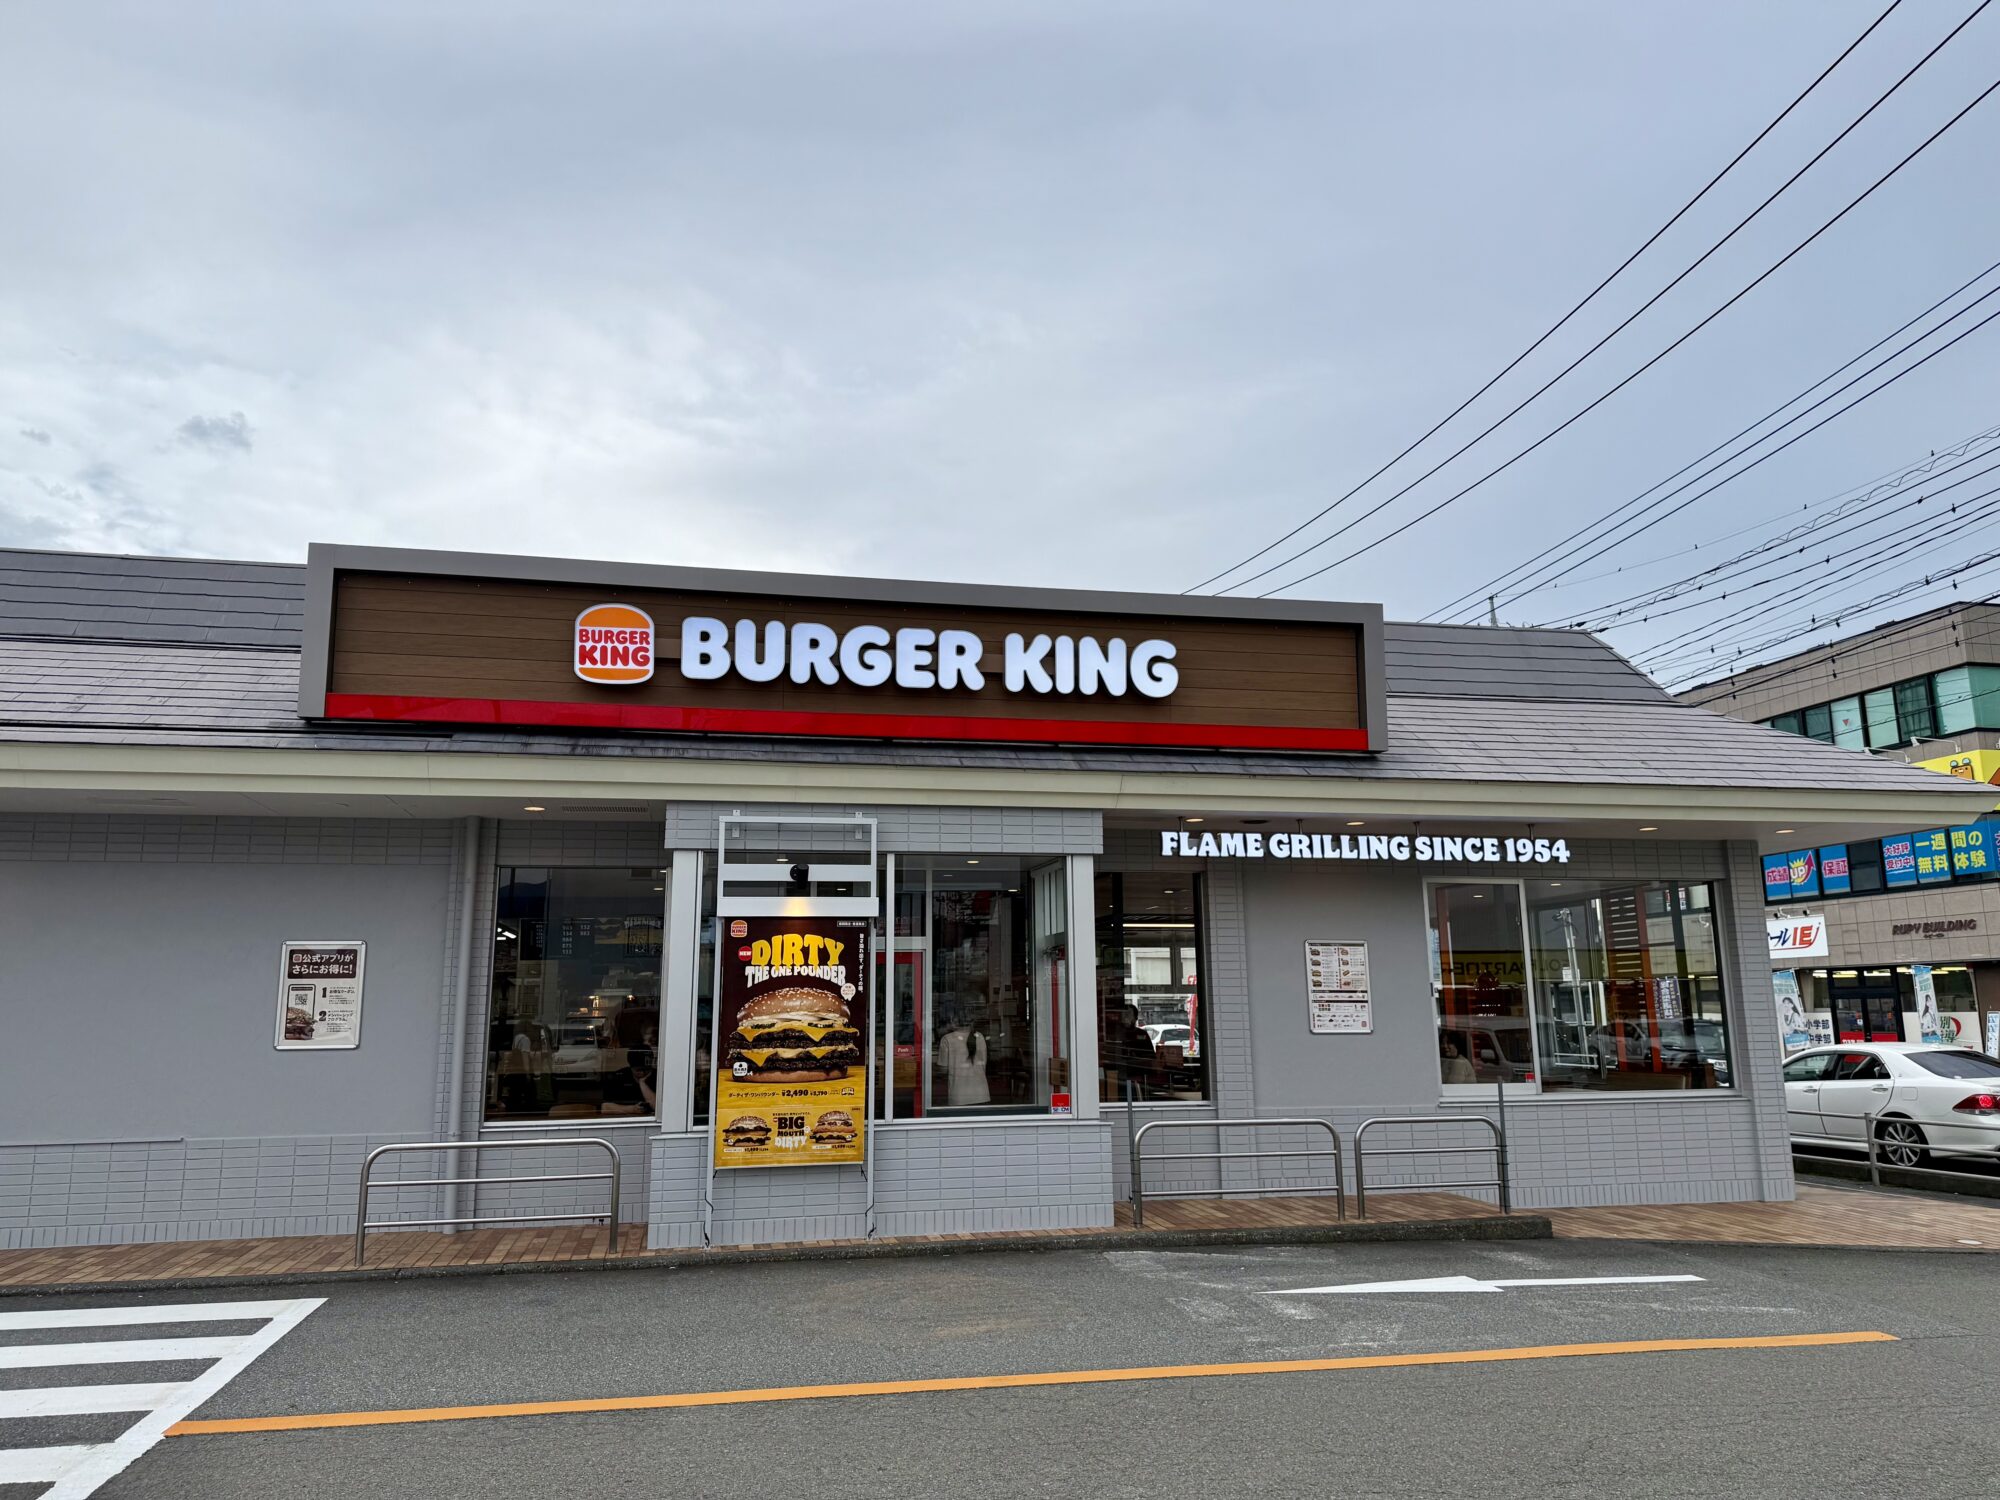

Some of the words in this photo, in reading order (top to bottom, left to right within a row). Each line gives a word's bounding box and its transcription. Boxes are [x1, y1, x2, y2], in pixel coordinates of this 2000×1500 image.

[578, 628, 651, 646] BURGER
[578, 644, 651, 668] KING
[680, 616, 985, 691] BURGER
[1003, 633, 1179, 698] KING
[1161, 831, 1264, 858] FLAME
[1269, 833, 1411, 861] GRILLING
[1415, 836, 1500, 862] SINCE
[1503, 838, 1570, 863] 1954
[1823, 859, 1848, 876] 保証
[1922, 918, 1977, 934] BUILDING
[751, 933, 845, 966] DIRTY
[302, 954, 354, 963] 公式アプリが
[292, 964, 353, 975] さらにお得に!
[745, 966, 770, 988] THE
[770, 966, 792, 978] ONE
[793, 966, 847, 987] POUNDER
[322, 987, 327, 998] 1
[318, 1010, 327, 1021] 2
[781, 1089, 809, 1098] ¥2,490
[777, 1116, 805, 1130] BIG
[774, 1136, 808, 1150] DIRTY
